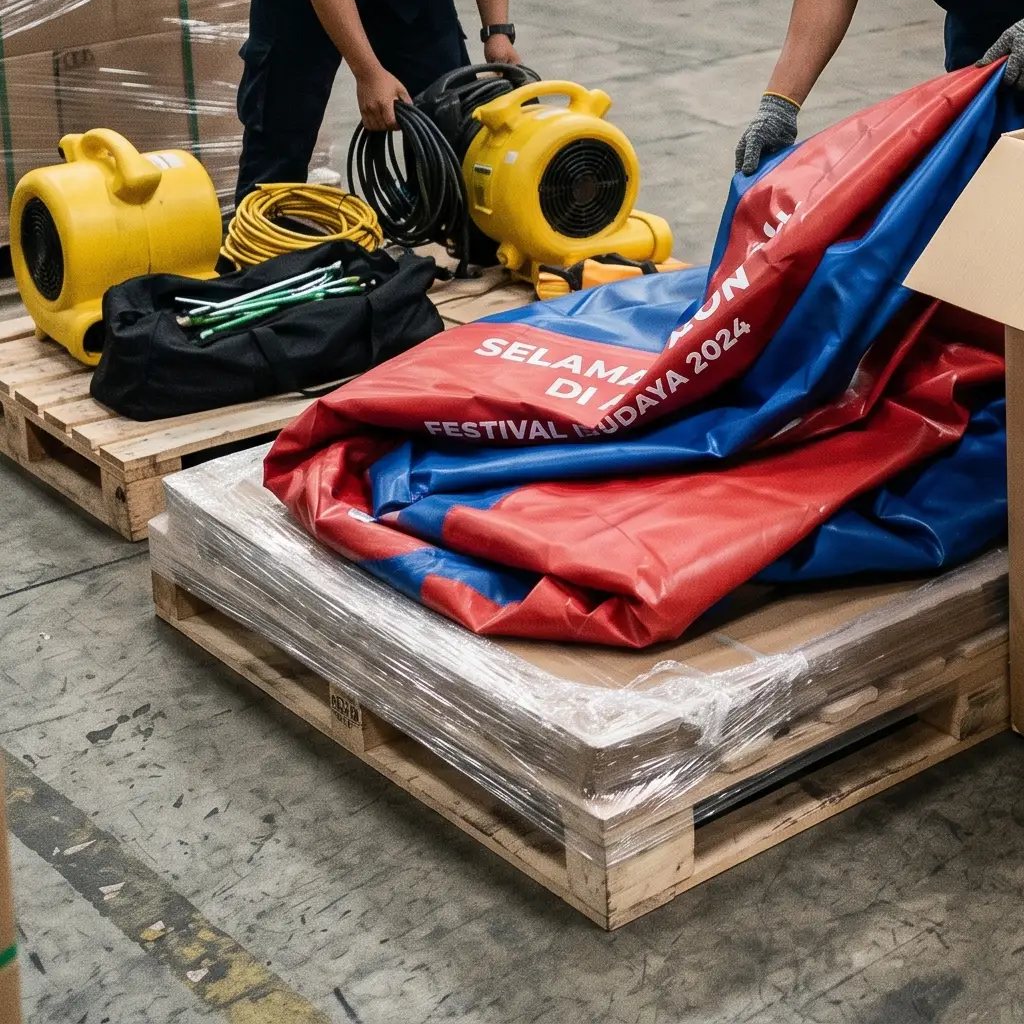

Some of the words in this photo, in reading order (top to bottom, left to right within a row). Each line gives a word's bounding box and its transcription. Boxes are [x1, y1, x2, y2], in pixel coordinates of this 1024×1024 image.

[423, 420, 567, 440] FESTIVAL
[686, 317, 751, 375] 2024
[545, 377, 597, 405] DI
